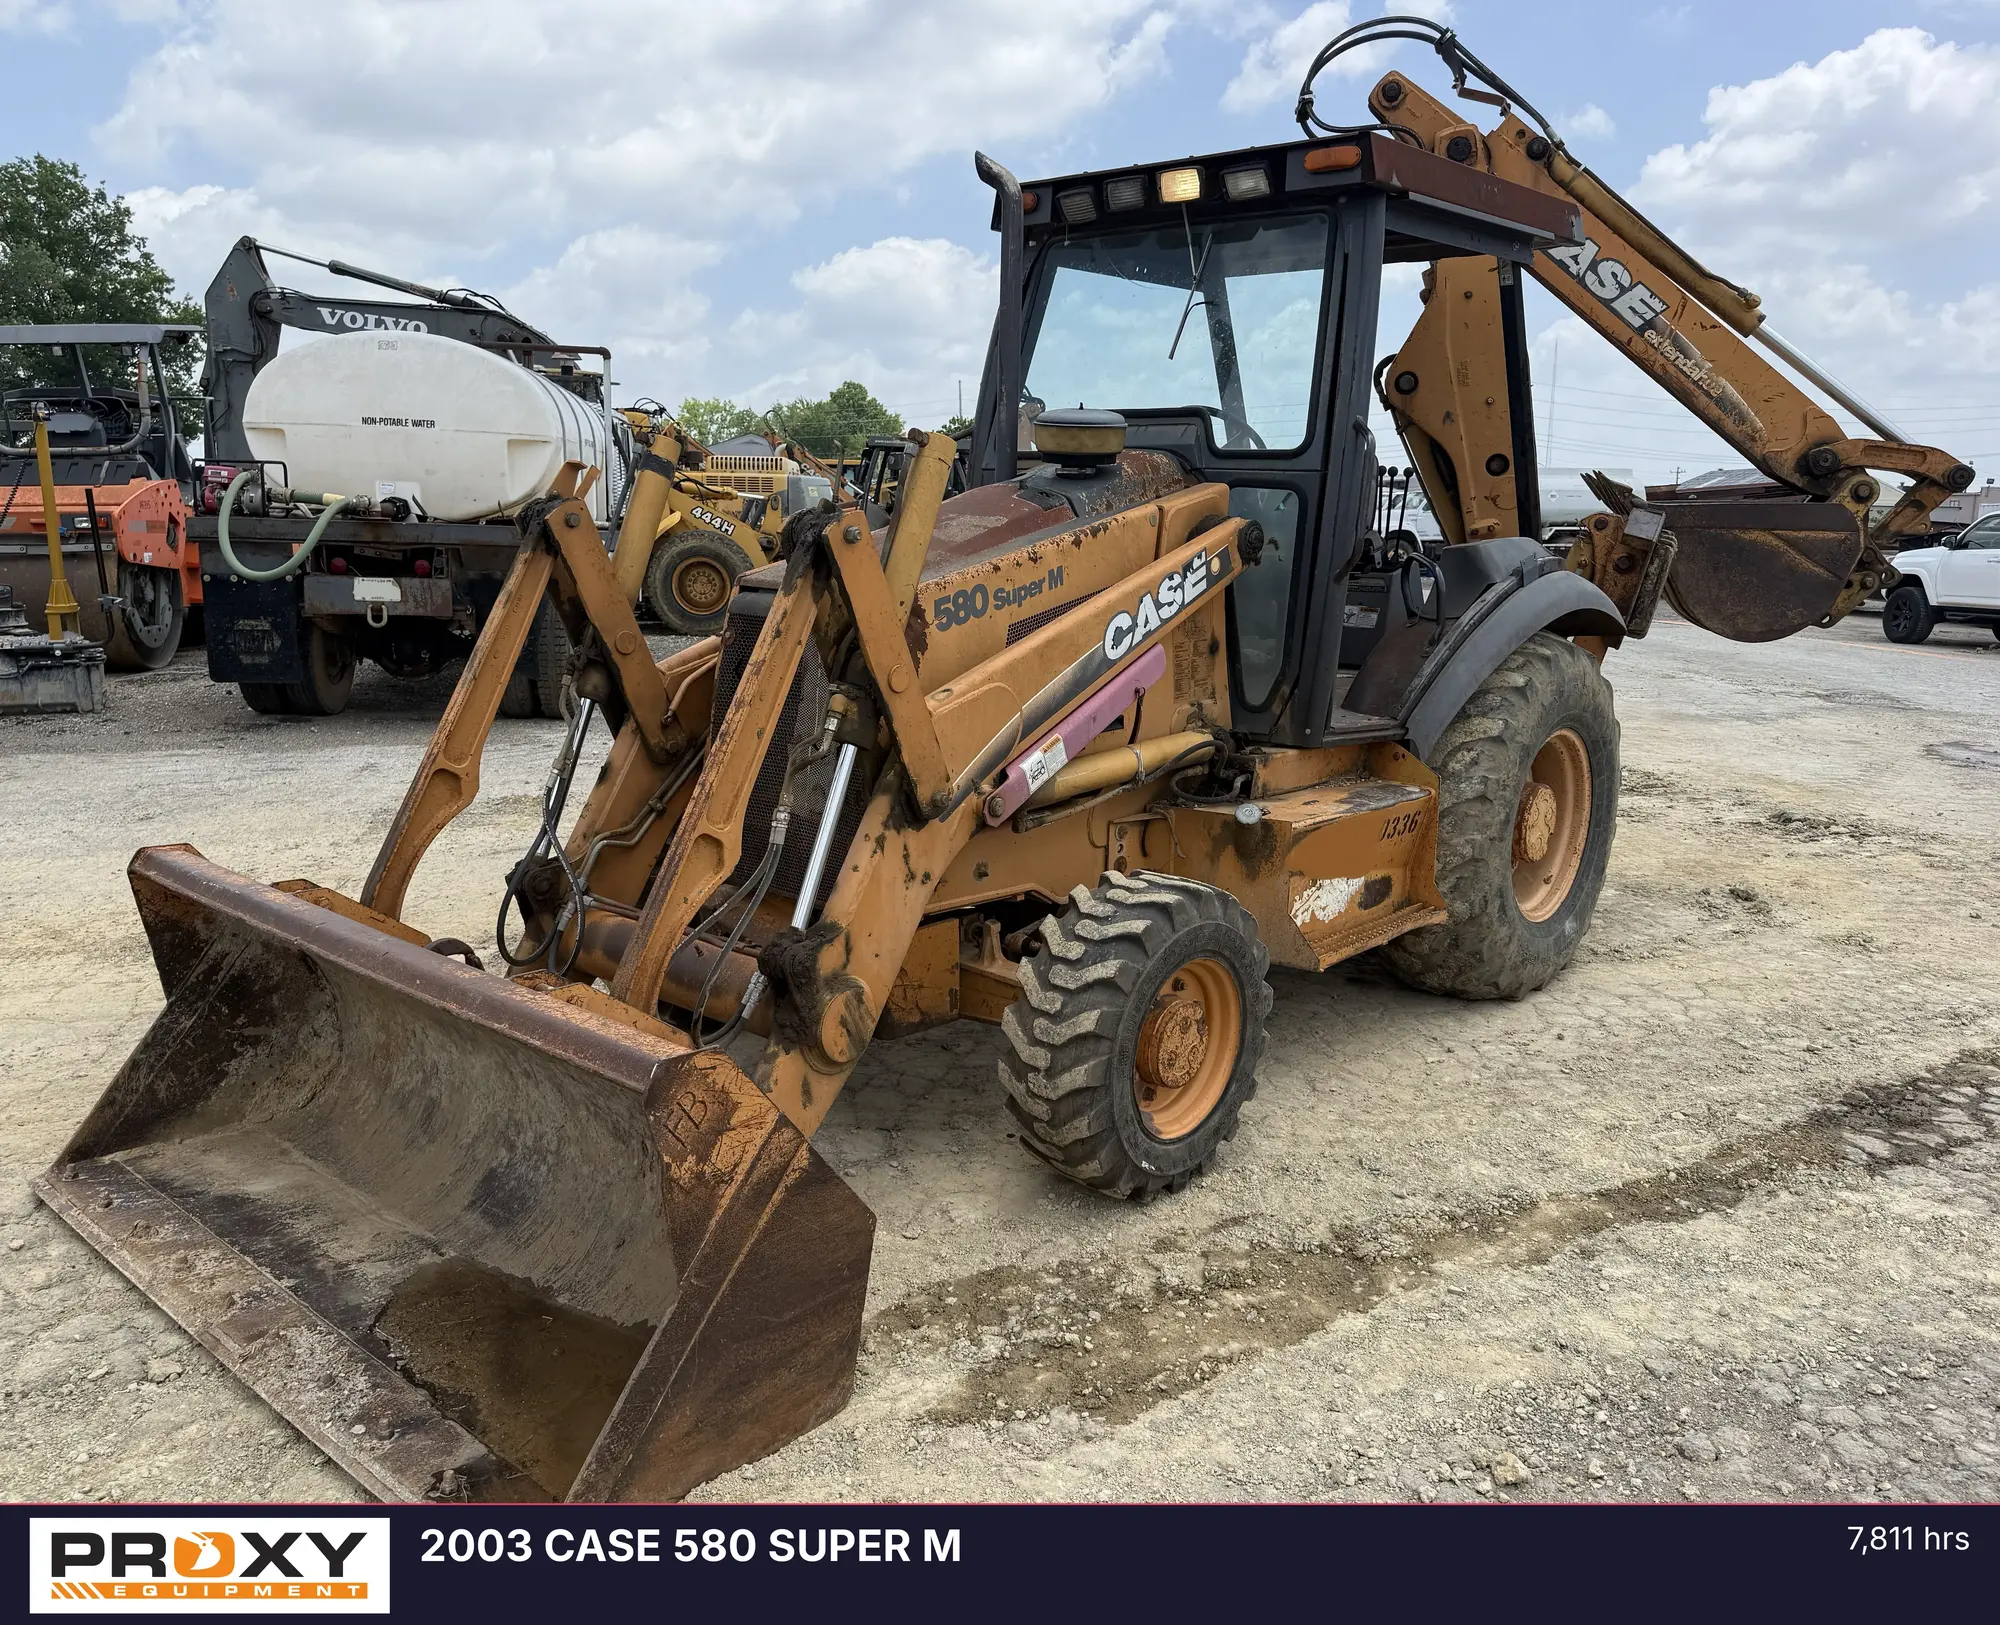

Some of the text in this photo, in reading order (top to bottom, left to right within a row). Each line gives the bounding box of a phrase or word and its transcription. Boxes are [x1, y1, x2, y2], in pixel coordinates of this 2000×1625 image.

[1546, 239, 1670, 329] ASE
[316, 306, 429, 334] VOLVO
[361, 416, 436, 429] NON-POTABLE WATER
[690, 505, 736, 537] 444H
[934, 565, 1064, 632] 580 Super M
[1103, 549, 1208, 661] CASE
